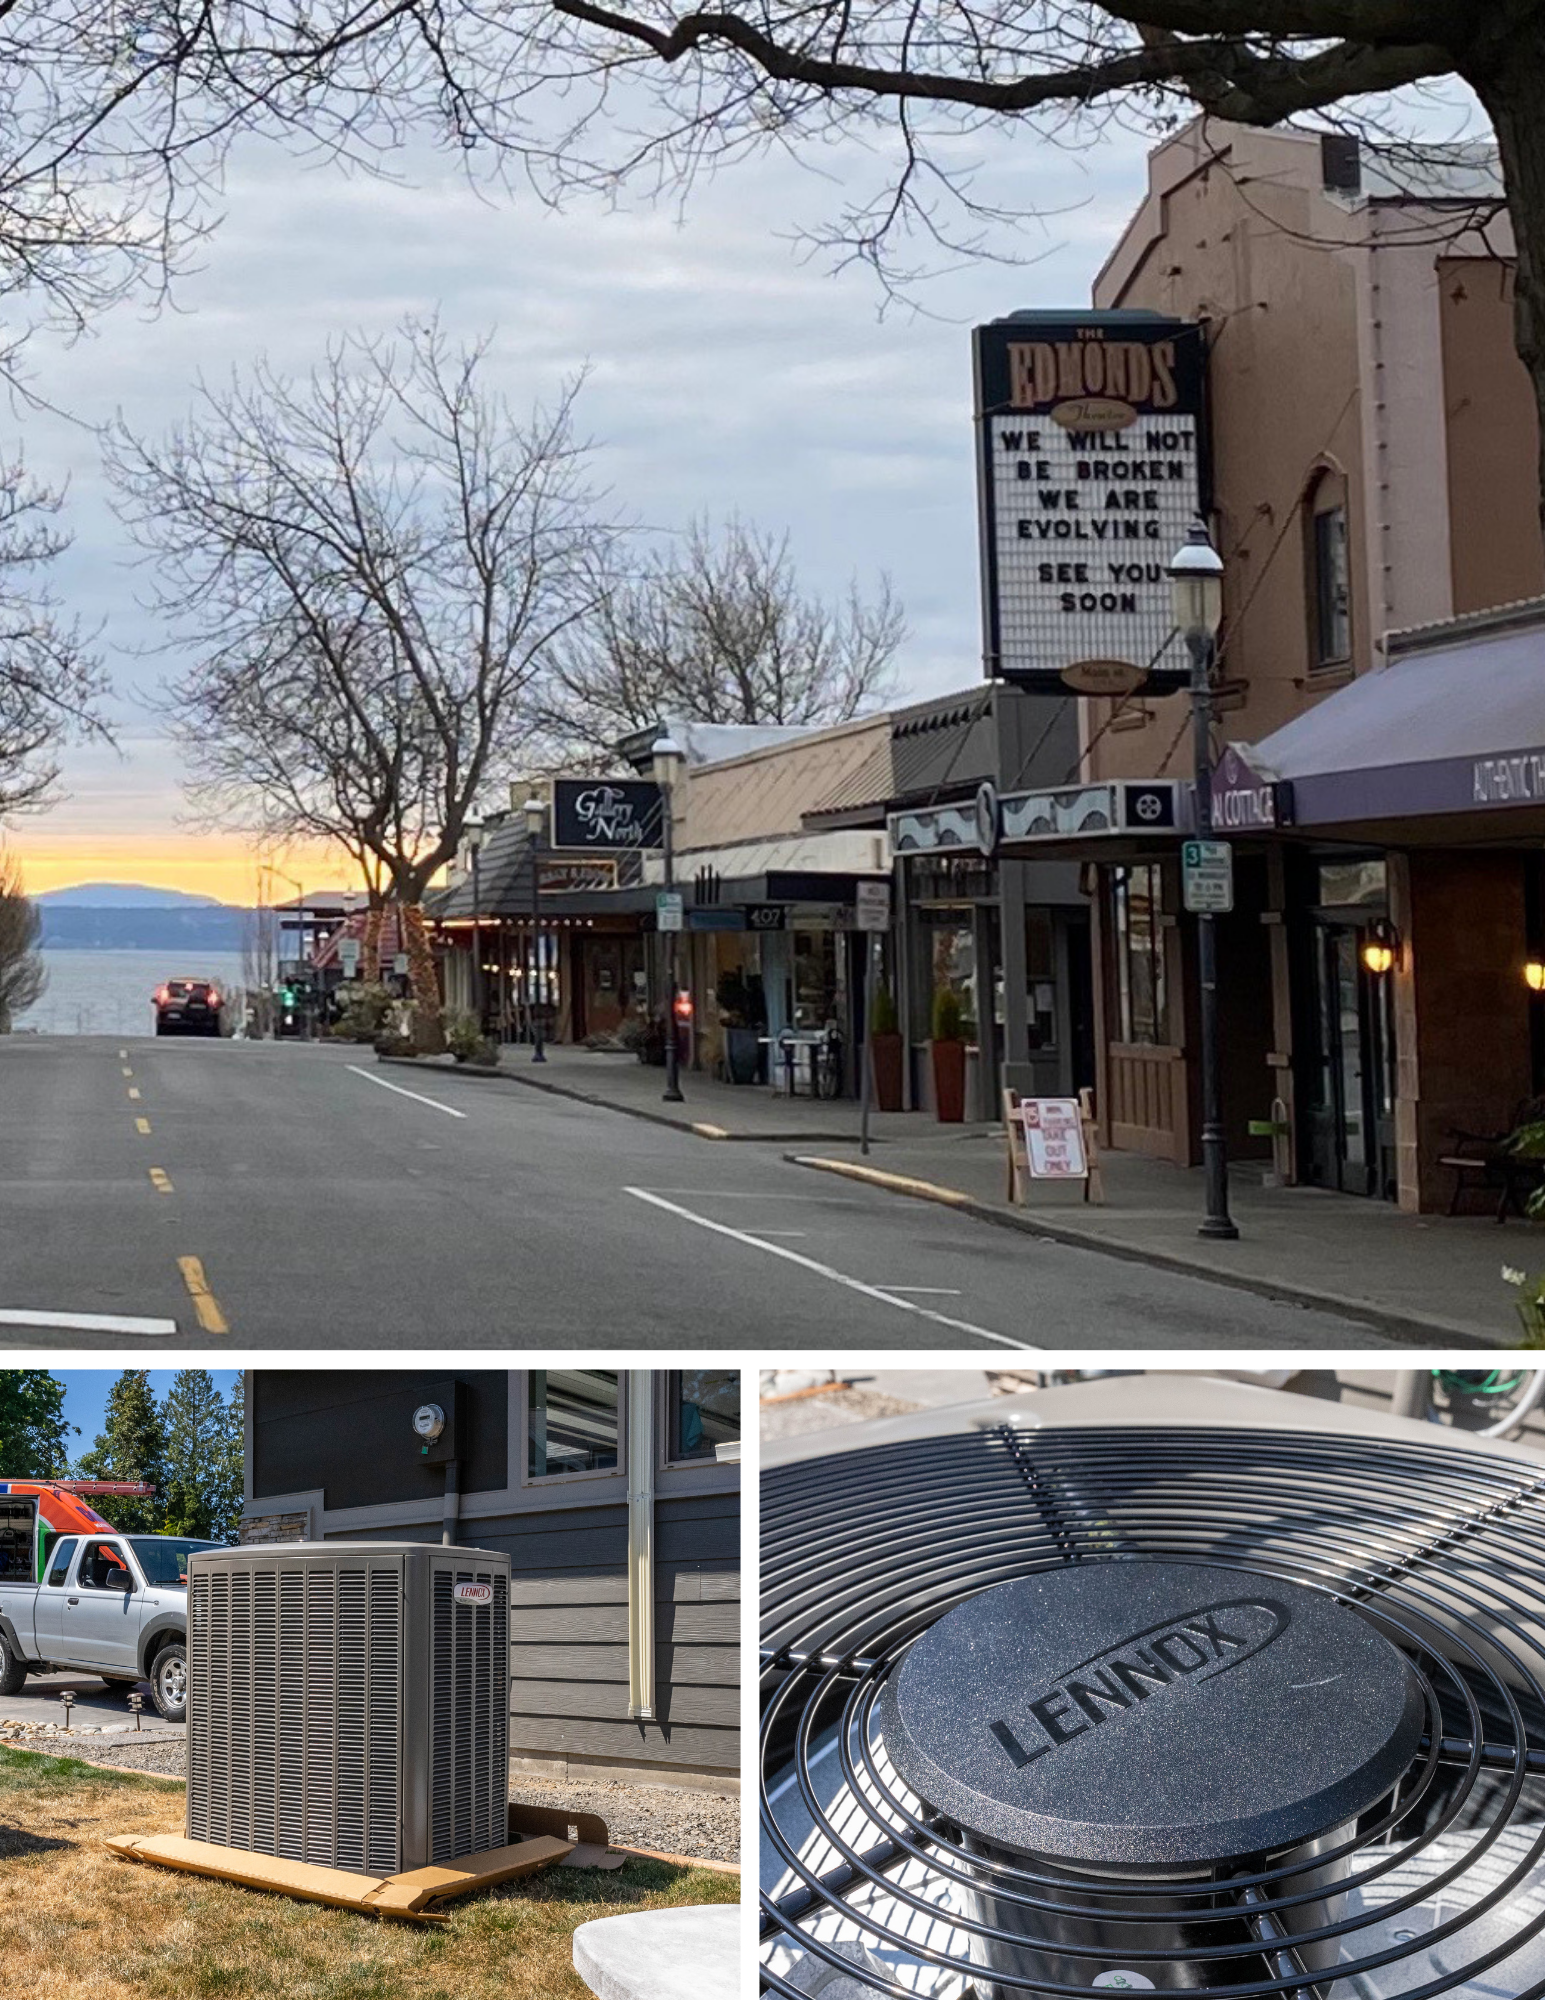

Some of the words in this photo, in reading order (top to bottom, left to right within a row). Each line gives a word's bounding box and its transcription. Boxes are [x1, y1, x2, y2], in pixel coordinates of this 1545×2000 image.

[1076, 328, 1104, 340] THE
[1007, 340, 1178, 408] EDMONDS
[1001, 431, 1041, 451] WE
[1067, 431, 1129, 451] WILL
[1147, 431, 1194, 451] NOT
[1017, 460, 1050, 480] BE
[1077, 460, 1183, 480] BROKEN
[1038, 489, 1079, 510] WE
[1105, 489, 1158, 510] ARE
[1018, 519, 1159, 539] EVOLVING
[1039, 562, 1089, 583] SEE
[1108, 562, 1161, 583] YOU
[1061, 592, 1136, 613] SOON
[1224, 786, 1274, 827] COTTAGE
[1187, 846, 1199, 865] 3
[750, 907, 781, 923] 407
[460, 1586, 486, 1598] LENNOX
[989, 1615, 1247, 1770] LENNOX
